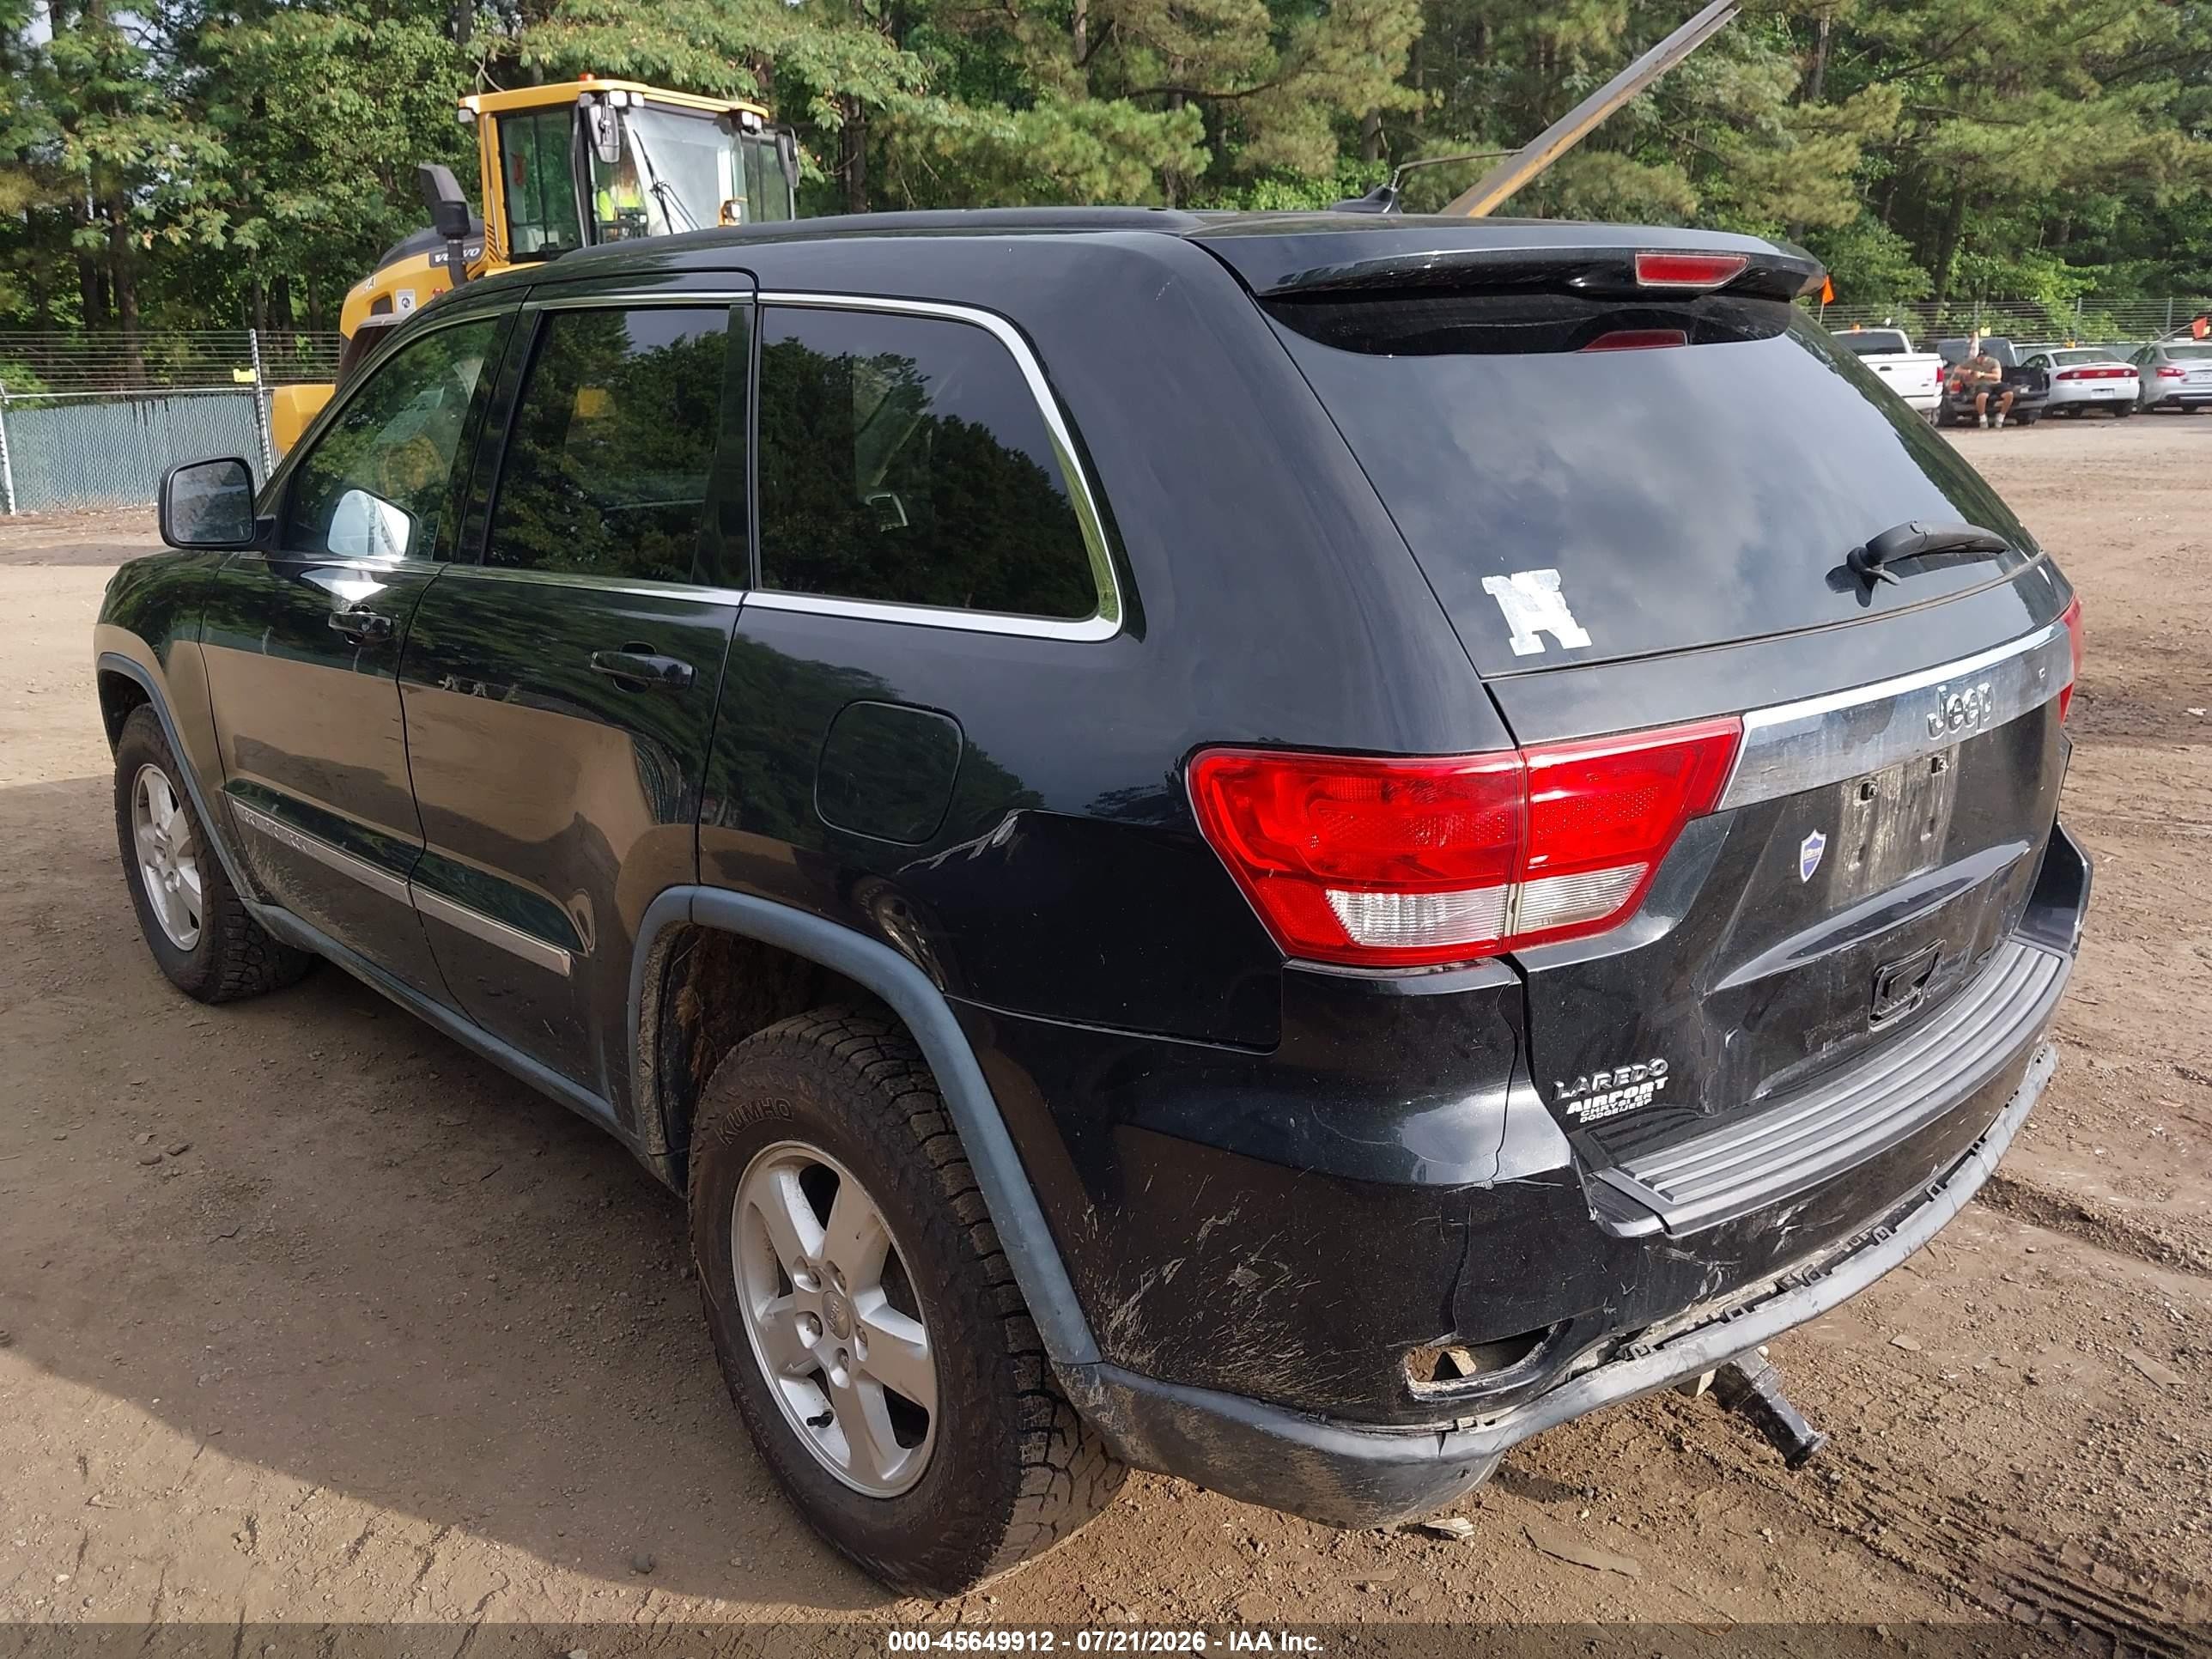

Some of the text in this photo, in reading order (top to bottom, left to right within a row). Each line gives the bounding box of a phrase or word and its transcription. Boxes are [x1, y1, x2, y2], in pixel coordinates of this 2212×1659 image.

[1926, 682, 1993, 740] Jeep
[1553, 1057, 1668, 1101] LAREDO
[1566, 1077, 1668, 1115] AIRPORT
[715, 1097, 793, 1146] KUMHO
